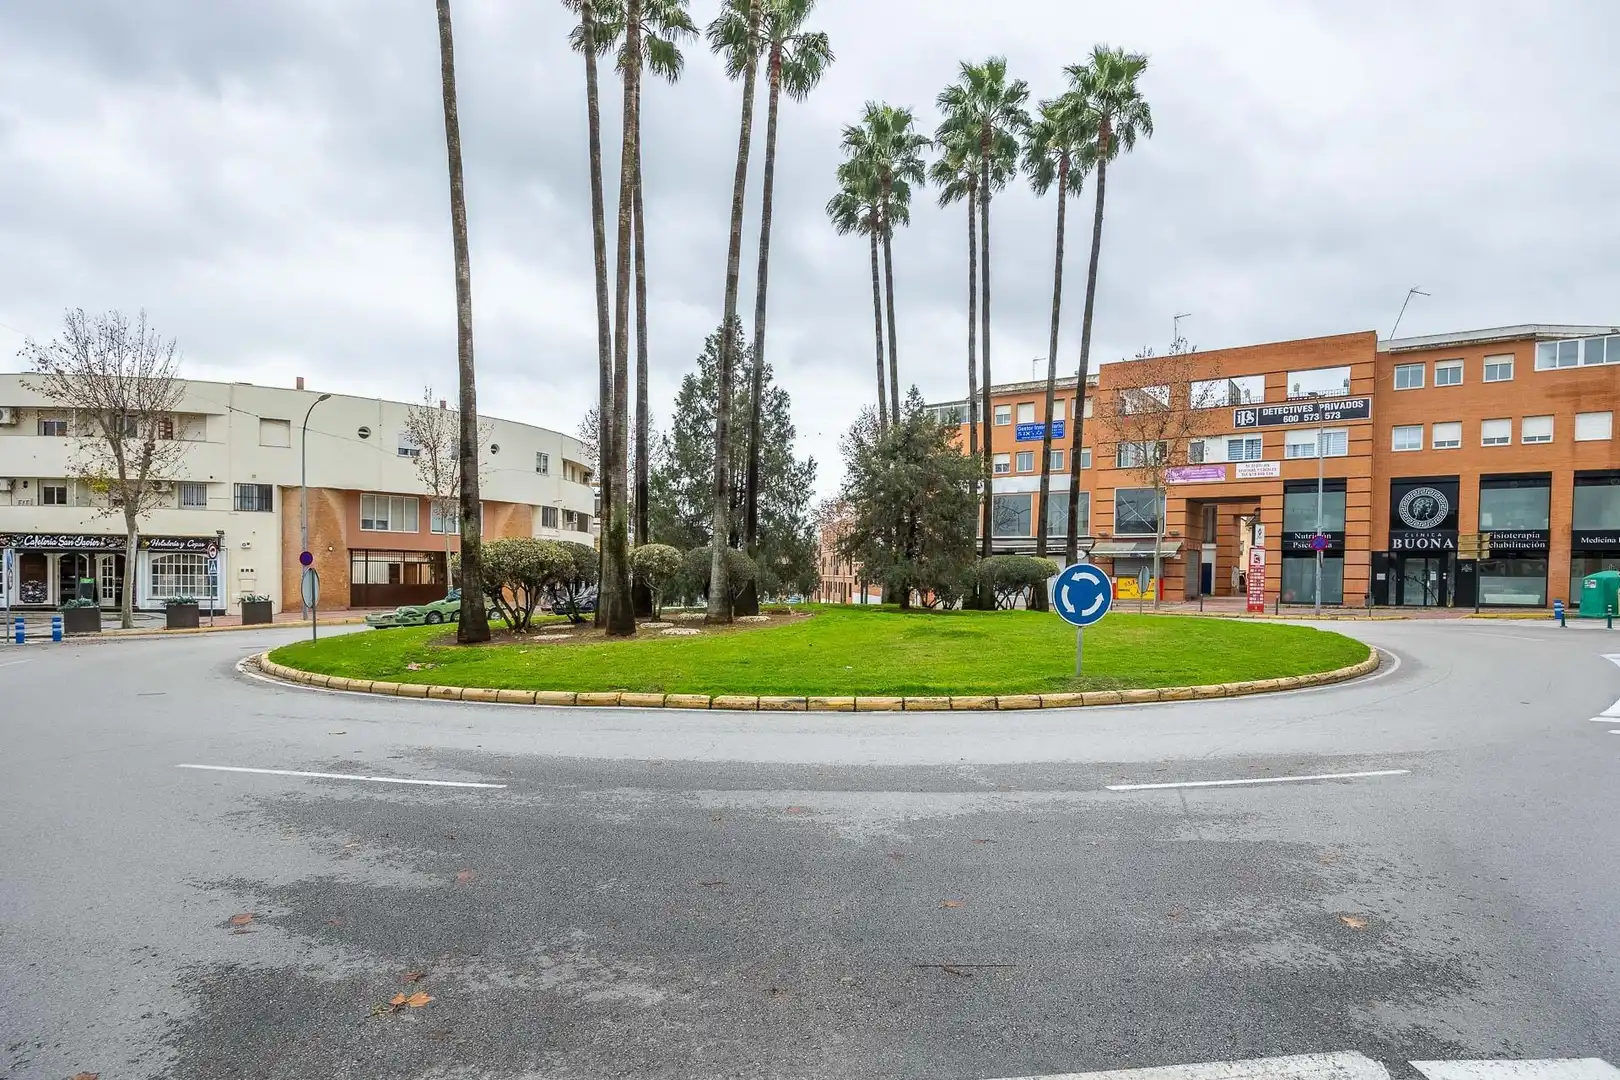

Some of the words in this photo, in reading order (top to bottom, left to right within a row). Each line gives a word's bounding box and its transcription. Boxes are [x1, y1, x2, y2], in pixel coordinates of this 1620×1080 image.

[1262, 404, 1313, 416] DETECTIVES
[1318, 400, 1364, 410] PRIVADOS
[1283, 415, 1299, 423] 600
[1303, 413, 1320, 422] 573
[1324, 411, 1341, 420] 573
[58, 536, 75, 546] San
[1392, 538, 1454, 549] BUONA
[1488, 541, 1546, 549] ehabilitación
[1580, 536, 1617, 544] Medicina
